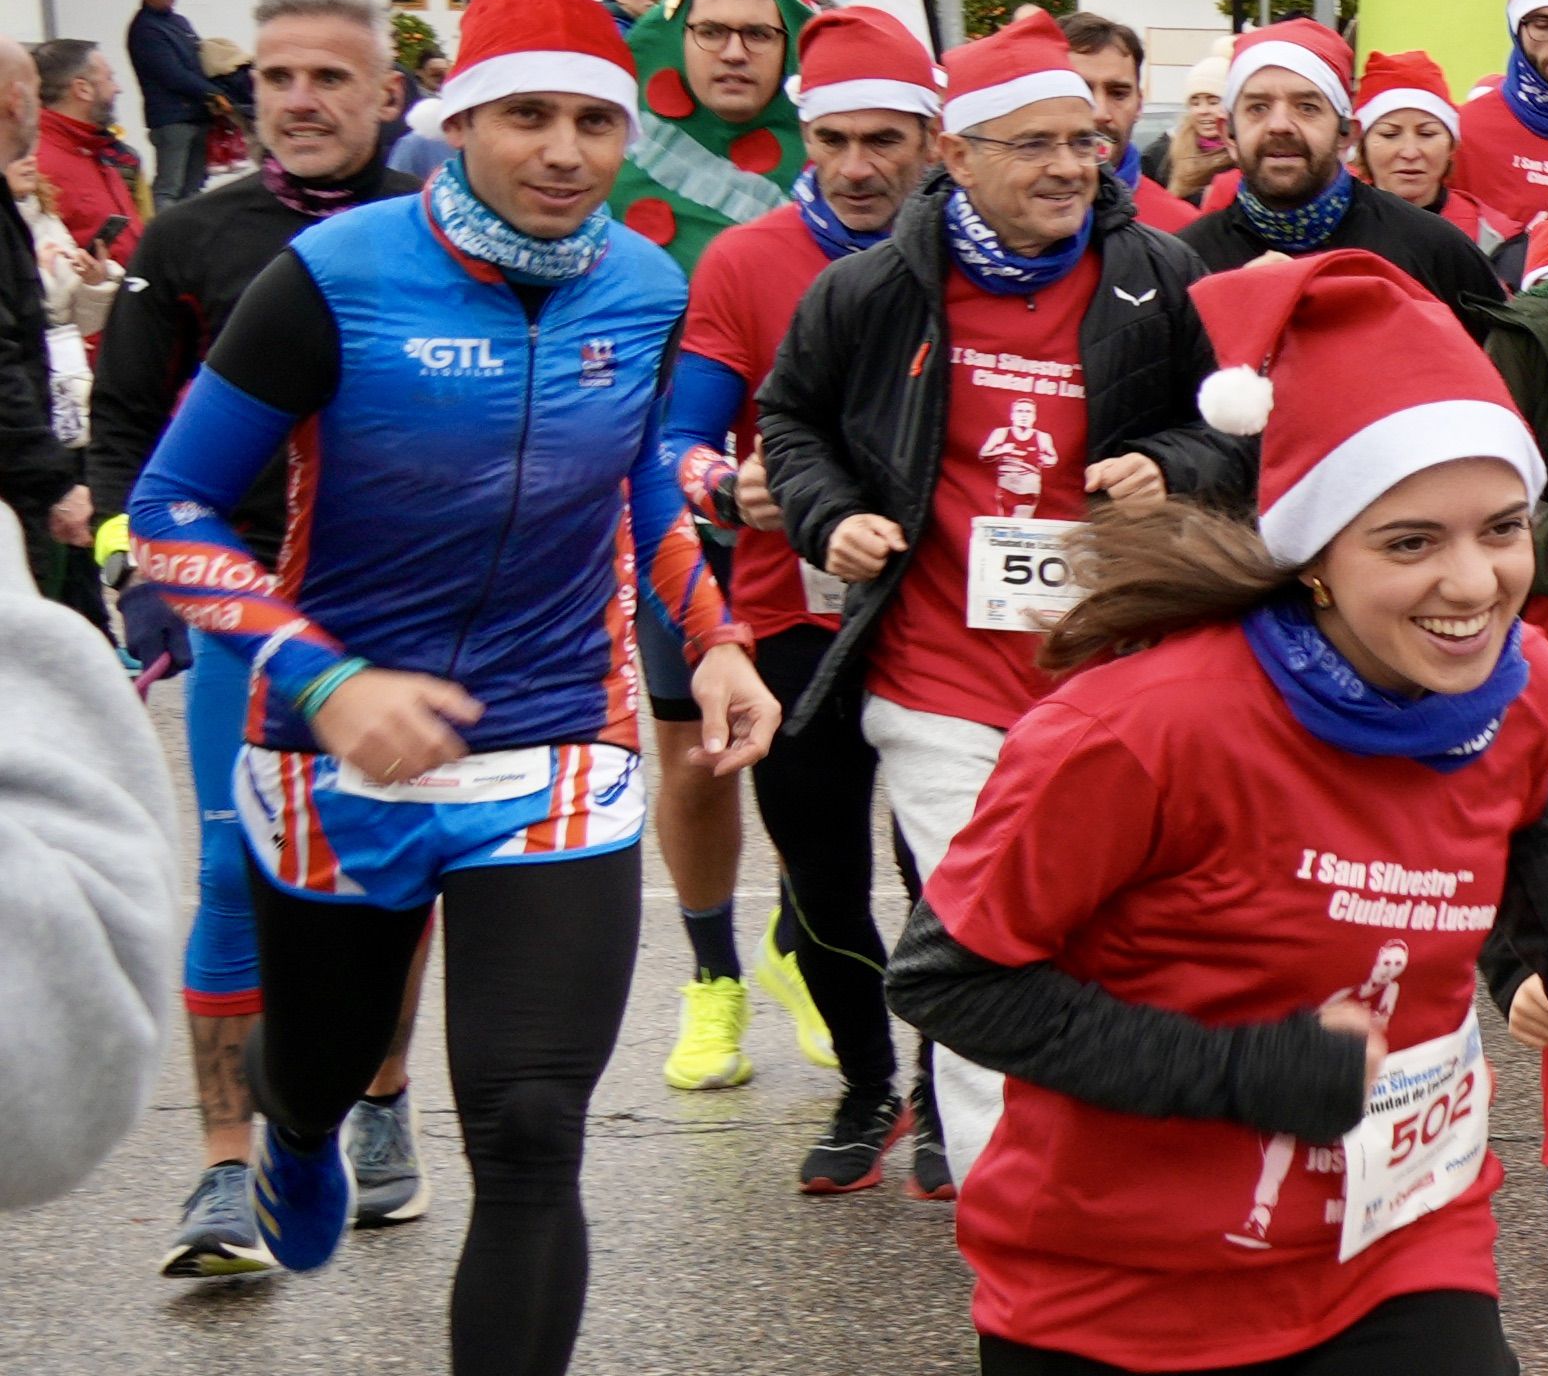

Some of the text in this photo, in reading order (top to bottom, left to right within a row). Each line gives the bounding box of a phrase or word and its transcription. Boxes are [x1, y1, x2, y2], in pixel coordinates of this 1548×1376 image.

[421, 338, 504, 369] GTL
[963, 348, 997, 369] San
[1297, 848, 1457, 899] I San Silvestre
[1329, 889, 1412, 930] Ciudad
[1411, 900, 1437, 931] de
[1387, 1070, 1475, 1169] 502
